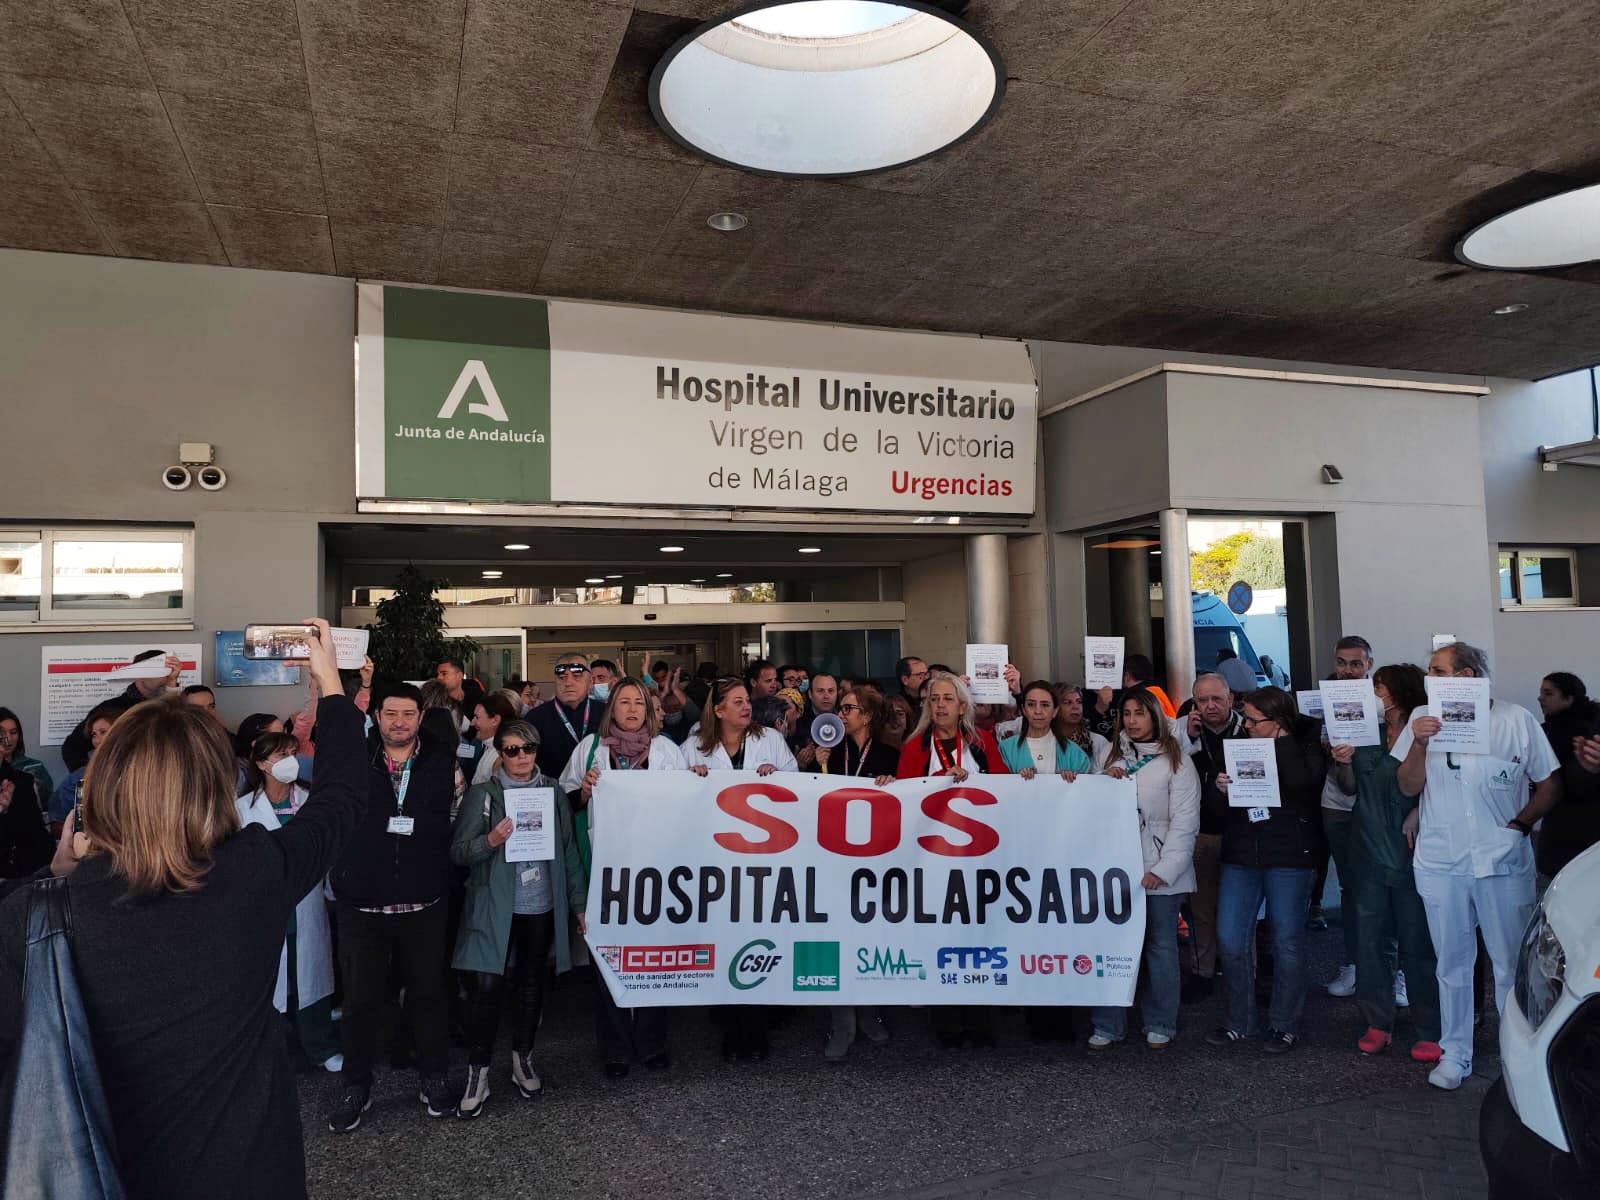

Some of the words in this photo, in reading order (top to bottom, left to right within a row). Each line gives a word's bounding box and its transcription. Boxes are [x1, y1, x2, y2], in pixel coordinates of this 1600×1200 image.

[656, 366, 800, 412] Hospital
[819, 378, 1015, 421] Universitario
[395, 425, 441, 439] Junta
[445, 427, 465, 440] de
[468, 428, 545, 443] Andalucía
[709, 419, 803, 456] Virgen
[823, 426, 858, 453] de
[877, 429, 899, 455] la
[917, 431, 1014, 459] Victoria
[708, 466, 741, 489] de
[753, 467, 848, 497] Málaga
[891, 470, 1013, 501] Urgencias
[713, 784, 1000, 857] SOS
[600, 866, 829, 925] HOSPITAL
[850, 867, 1133, 925] COLAPSADO
[627, 950, 693, 967] CCOO
[739, 954, 782, 974] CSIF
[937, 947, 1009, 970] FTPS
[1020, 954, 1069, 976] UGT
[635, 973, 645, 981] de
[646, 972, 676, 981] sanidad
[683, 971, 715, 980] sectores
[652, 981, 662, 990] de
[796, 975, 838, 987] SATSE
[941, 973, 959, 985] SAE
[964, 974, 990, 984] SMP
